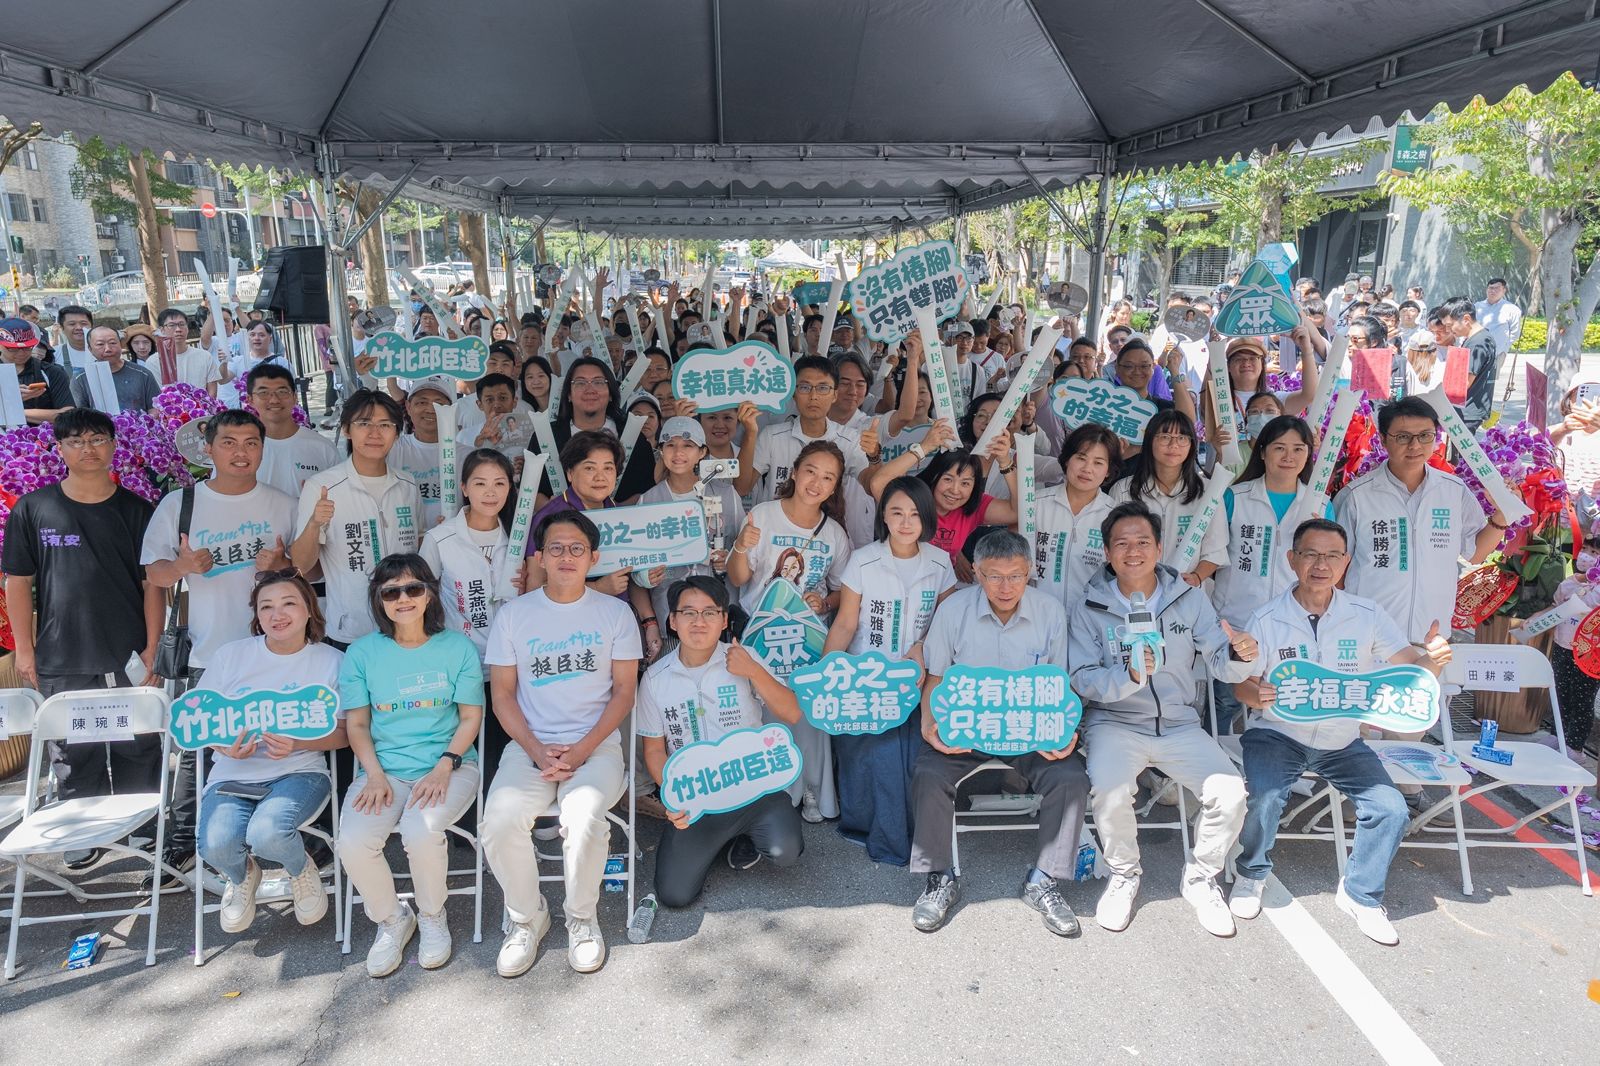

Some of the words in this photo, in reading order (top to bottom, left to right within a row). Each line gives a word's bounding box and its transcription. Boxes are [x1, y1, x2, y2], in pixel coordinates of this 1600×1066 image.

[869, 275, 958, 333] 只有雙腳
[370, 345, 480, 372] 竹北邱臣遠
[680, 365, 787, 398] 幸福真永遠
[930, 352, 950, 408] 臣遠勝選
[1003, 368, 1038, 418] 竹北幸福
[1063, 402, 1142, 439] 的幸福
[1066, 386, 1153, 417] 一分之一
[1215, 376, 1231, 425] 臣遠勝選
[295, 462, 319, 472] Youth
[1314, 435, 1342, 492] 竹北幸福
[1450, 426, 1492, 478] 竹北幸福
[443, 447, 456, 504] 臣遠勝選
[1025, 476, 1035, 533] 竹北幸福
[509, 497, 530, 556] 臣遠勝選
[1371, 519, 1390, 568] 徐勝凌
[345, 523, 365, 572] 劉文軒
[619, 553, 668, 567] 竹北邱臣遠
[870, 600, 885, 648] 游雅婷
[530, 648, 598, 678] 挺臣遠
[794, 657, 916, 691] 一分之一
[1468, 670, 1514, 681] 田耕豪
[812, 690, 900, 720] 的幸福
[1277, 676, 1432, 721] 幸福真永遠
[72, 715, 128, 730] 陳琬惠
[175, 699, 329, 743] 竹北邱臣遠
[833, 722, 878, 731] 竹北邱臣遠
[947, 709, 1065, 743] 只有雙腳
[983, 742, 1029, 751] 竹北邱臣遠
[671, 744, 793, 803] 竹北邱臣遠
[607, 864, 621, 872] FIN
